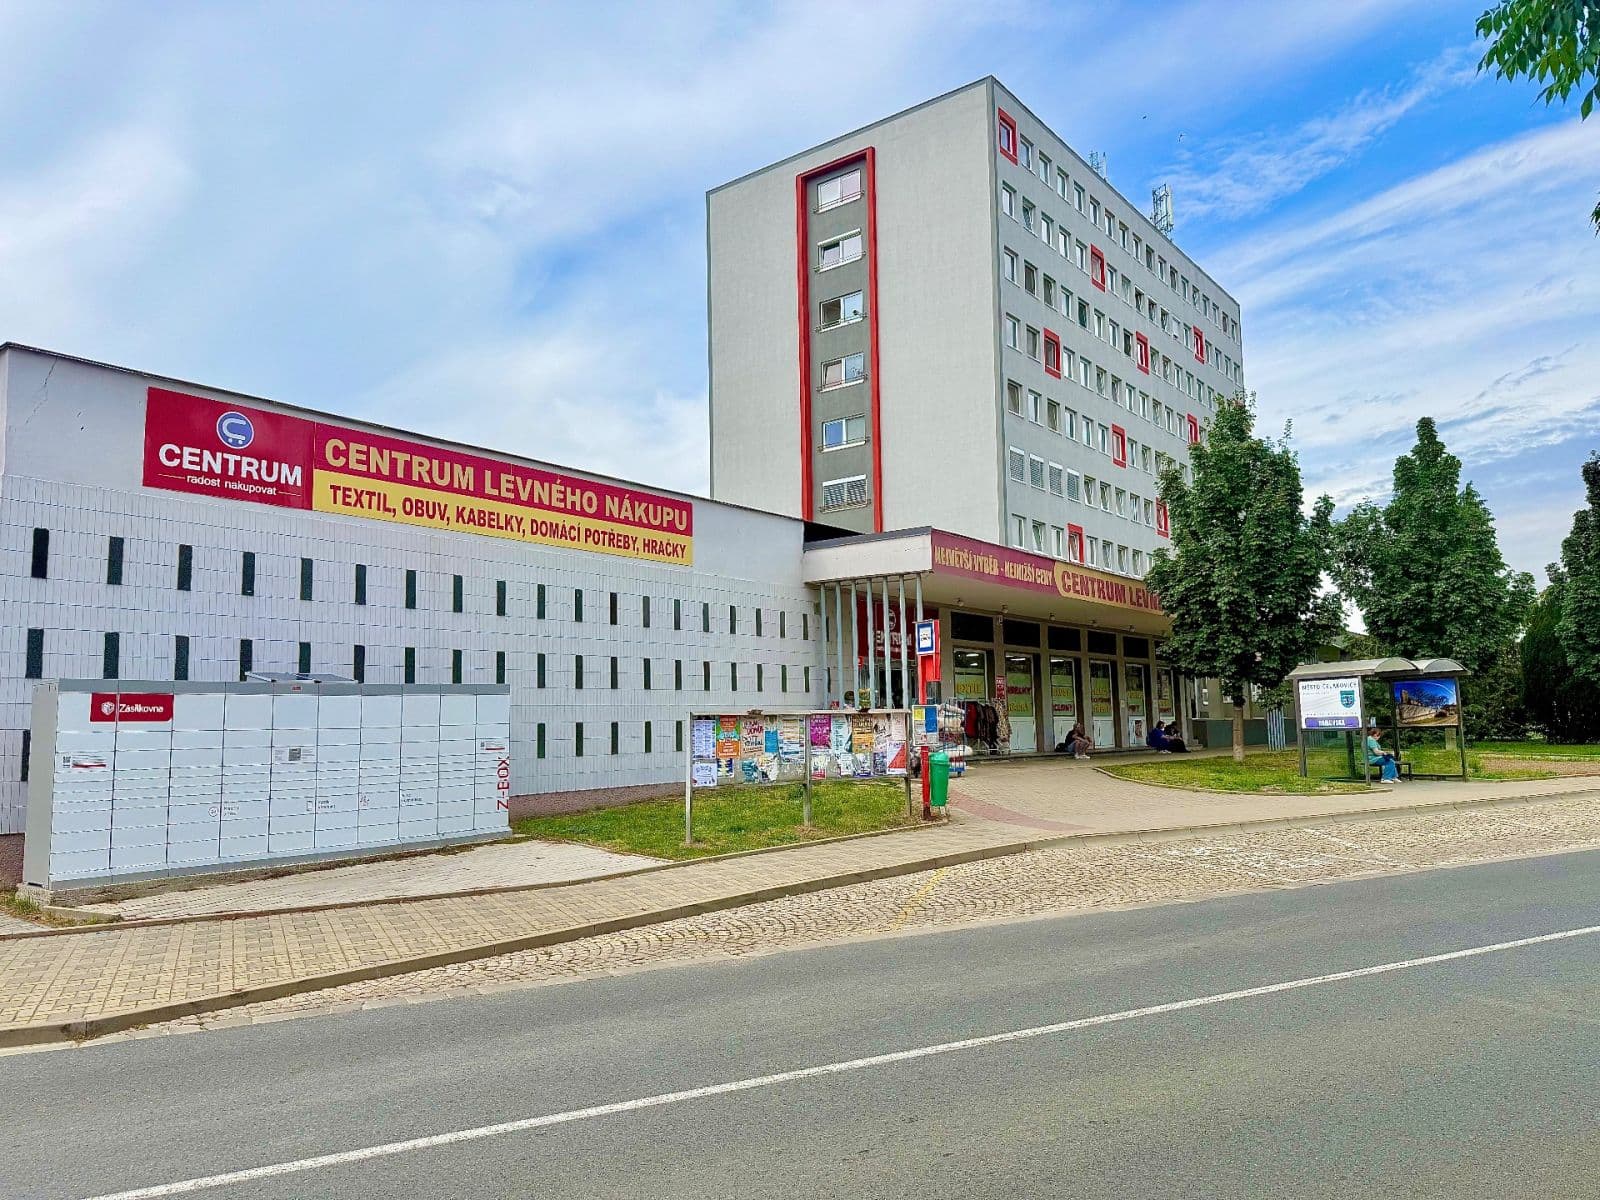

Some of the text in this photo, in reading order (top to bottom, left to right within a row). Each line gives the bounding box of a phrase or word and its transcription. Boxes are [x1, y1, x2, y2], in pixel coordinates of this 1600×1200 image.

[158, 443, 302, 487] CENTRUM
[186, 474, 277, 496] radost nakupovat
[324, 438, 688, 531] CENTRUM LEVNÉHO NÁKUPU
[329, 484, 687, 559] TEXTIL, OBUV, KABELKY, DOMÁCÍ POTŘEBY, HRAČKY
[1061, 570, 1127, 604] CENTRUM
[118, 703, 164, 713] Zásilkovna
[496, 756, 510, 811] Z-BOX
